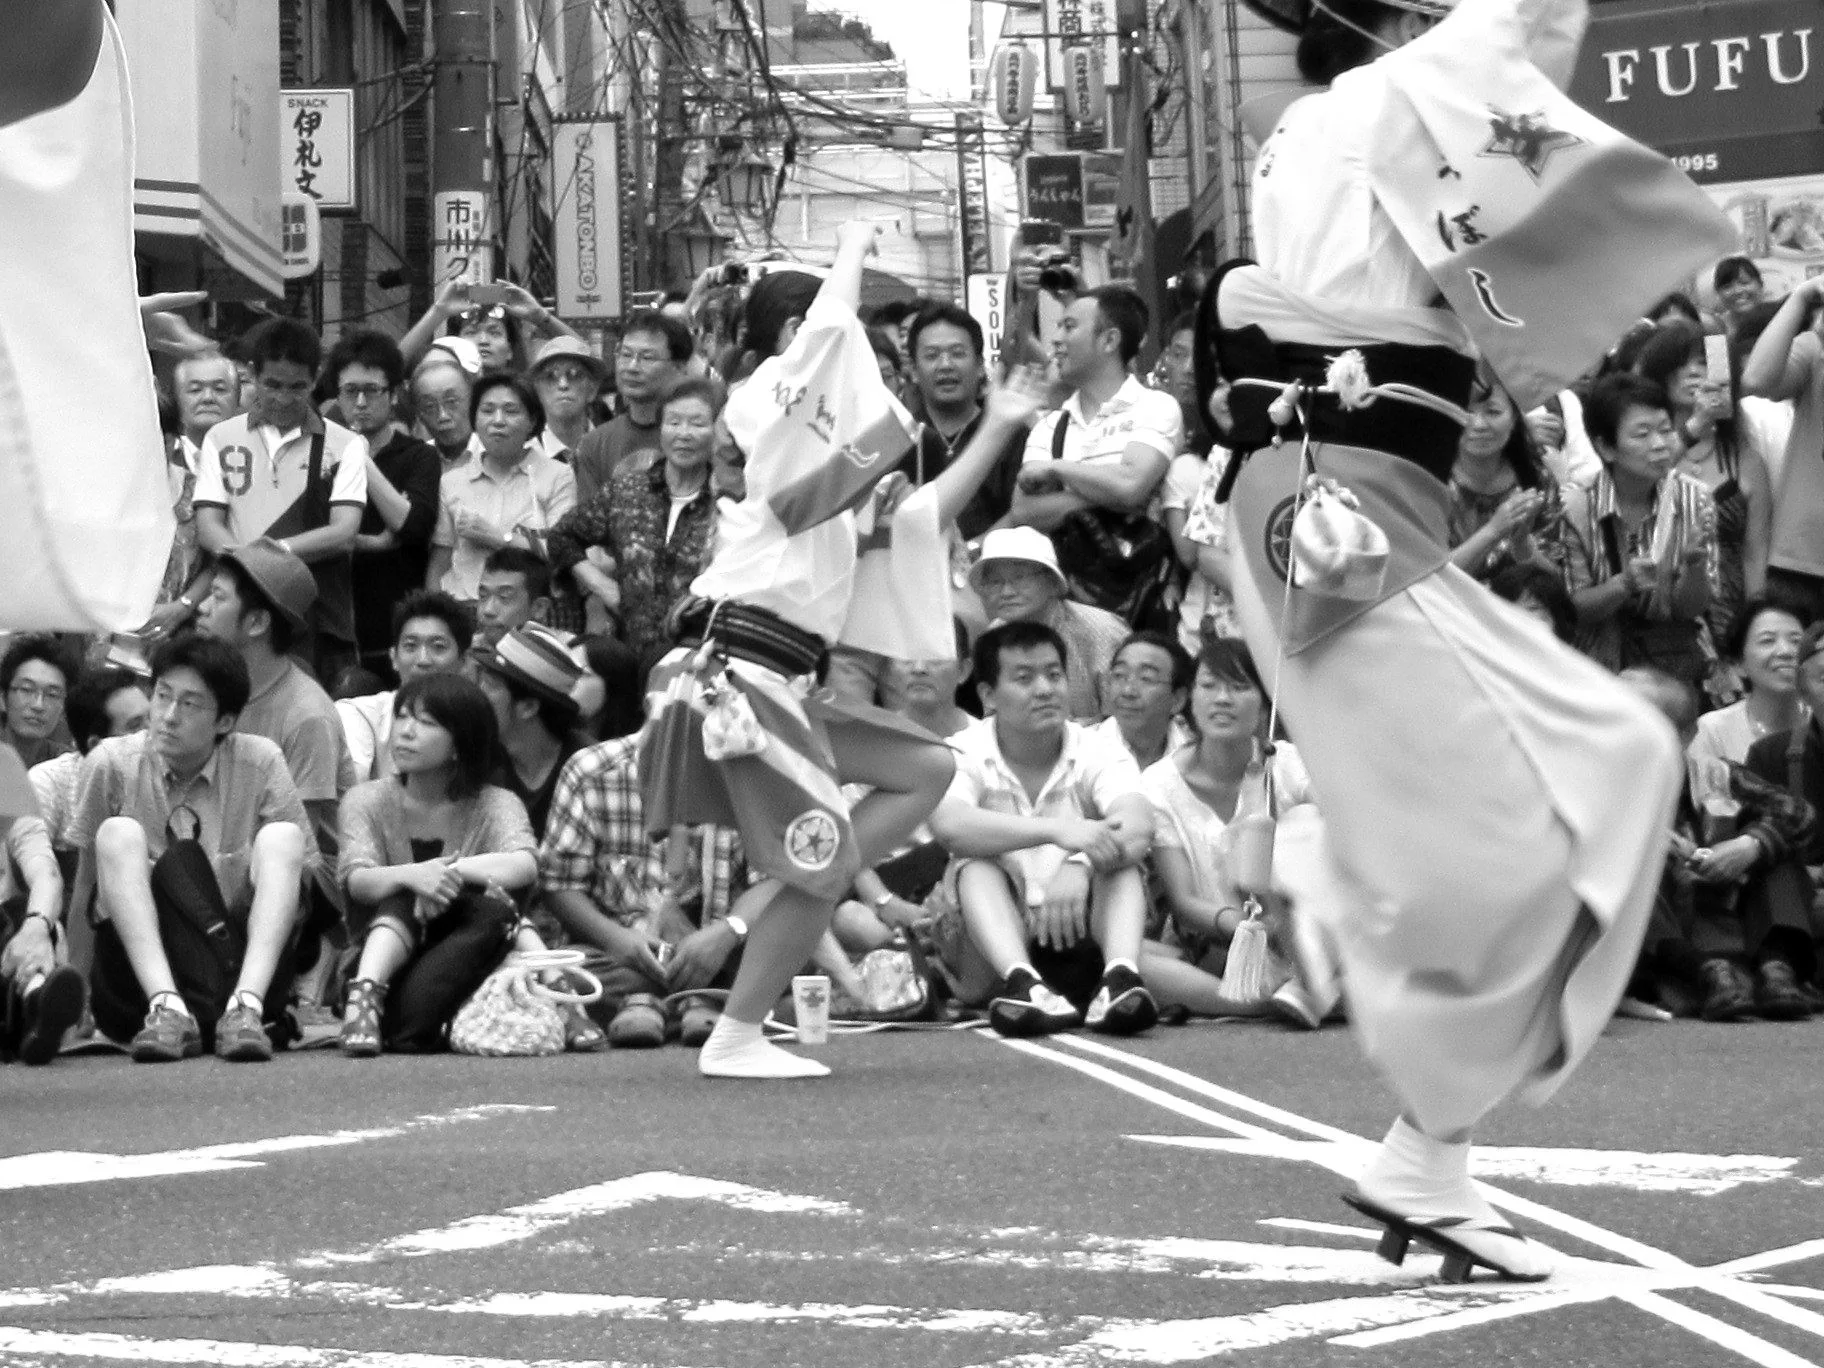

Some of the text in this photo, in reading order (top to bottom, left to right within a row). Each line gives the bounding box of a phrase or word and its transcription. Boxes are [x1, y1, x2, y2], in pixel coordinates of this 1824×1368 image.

[1601, 29, 1814, 104] FUFU
[287, 97, 329, 109] SNACK
[219, 445, 252, 496] 9
